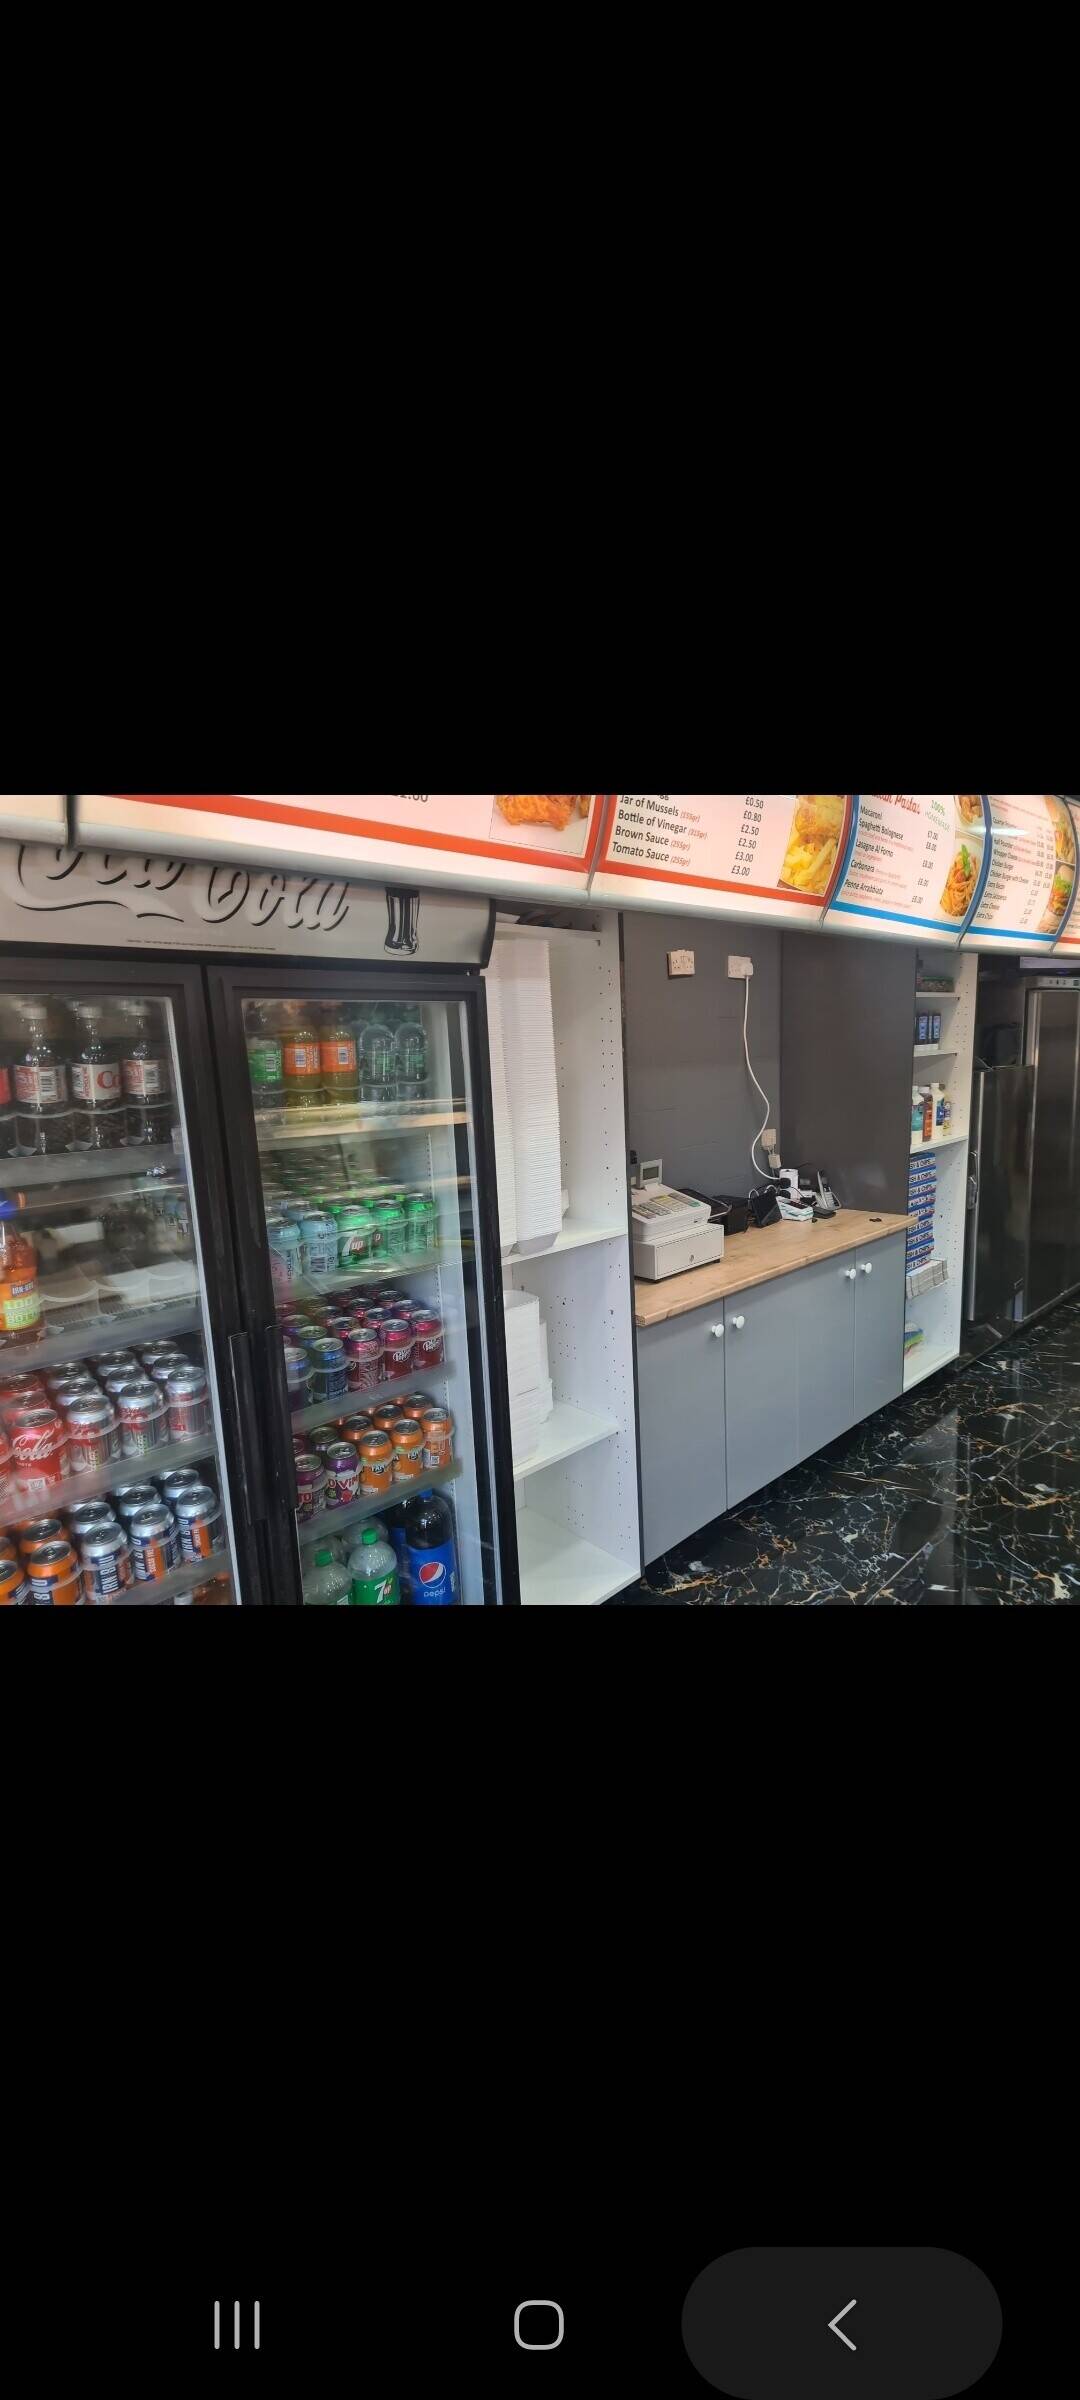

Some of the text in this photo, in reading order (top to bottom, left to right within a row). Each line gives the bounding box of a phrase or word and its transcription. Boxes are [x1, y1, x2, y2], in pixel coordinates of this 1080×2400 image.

[635, 798, 645, 808] of
[646, 800, 679, 817] Mussels
[745, 796, 764, 809] £0.50
[743, 810, 762, 823] £0.80
[860, 805, 883, 821] Macaroni
[618, 809, 644, 825] Bottle
[646, 817, 656, 827] of
[657, 819, 688, 835] Vinegar
[741, 824, 760, 836] £2.50
[859, 817, 881, 831] Spaghetti
[881, 825, 904, 841] Bolognese
[615, 826, 643, 841] Brown
[645, 832, 670, 846] Sauce
[738, 837, 757, 850] £2.50
[612, 841, 644, 858] Tomato
[645, 848, 670, 862] Sauce
[735, 851, 754, 863] £3.00
[731, 865, 751, 877] £3.00
[850, 859, 875, 873] Carbonara
[845, 879, 860, 891] Penne
[424, 1587, 446, 1598] pepsi
